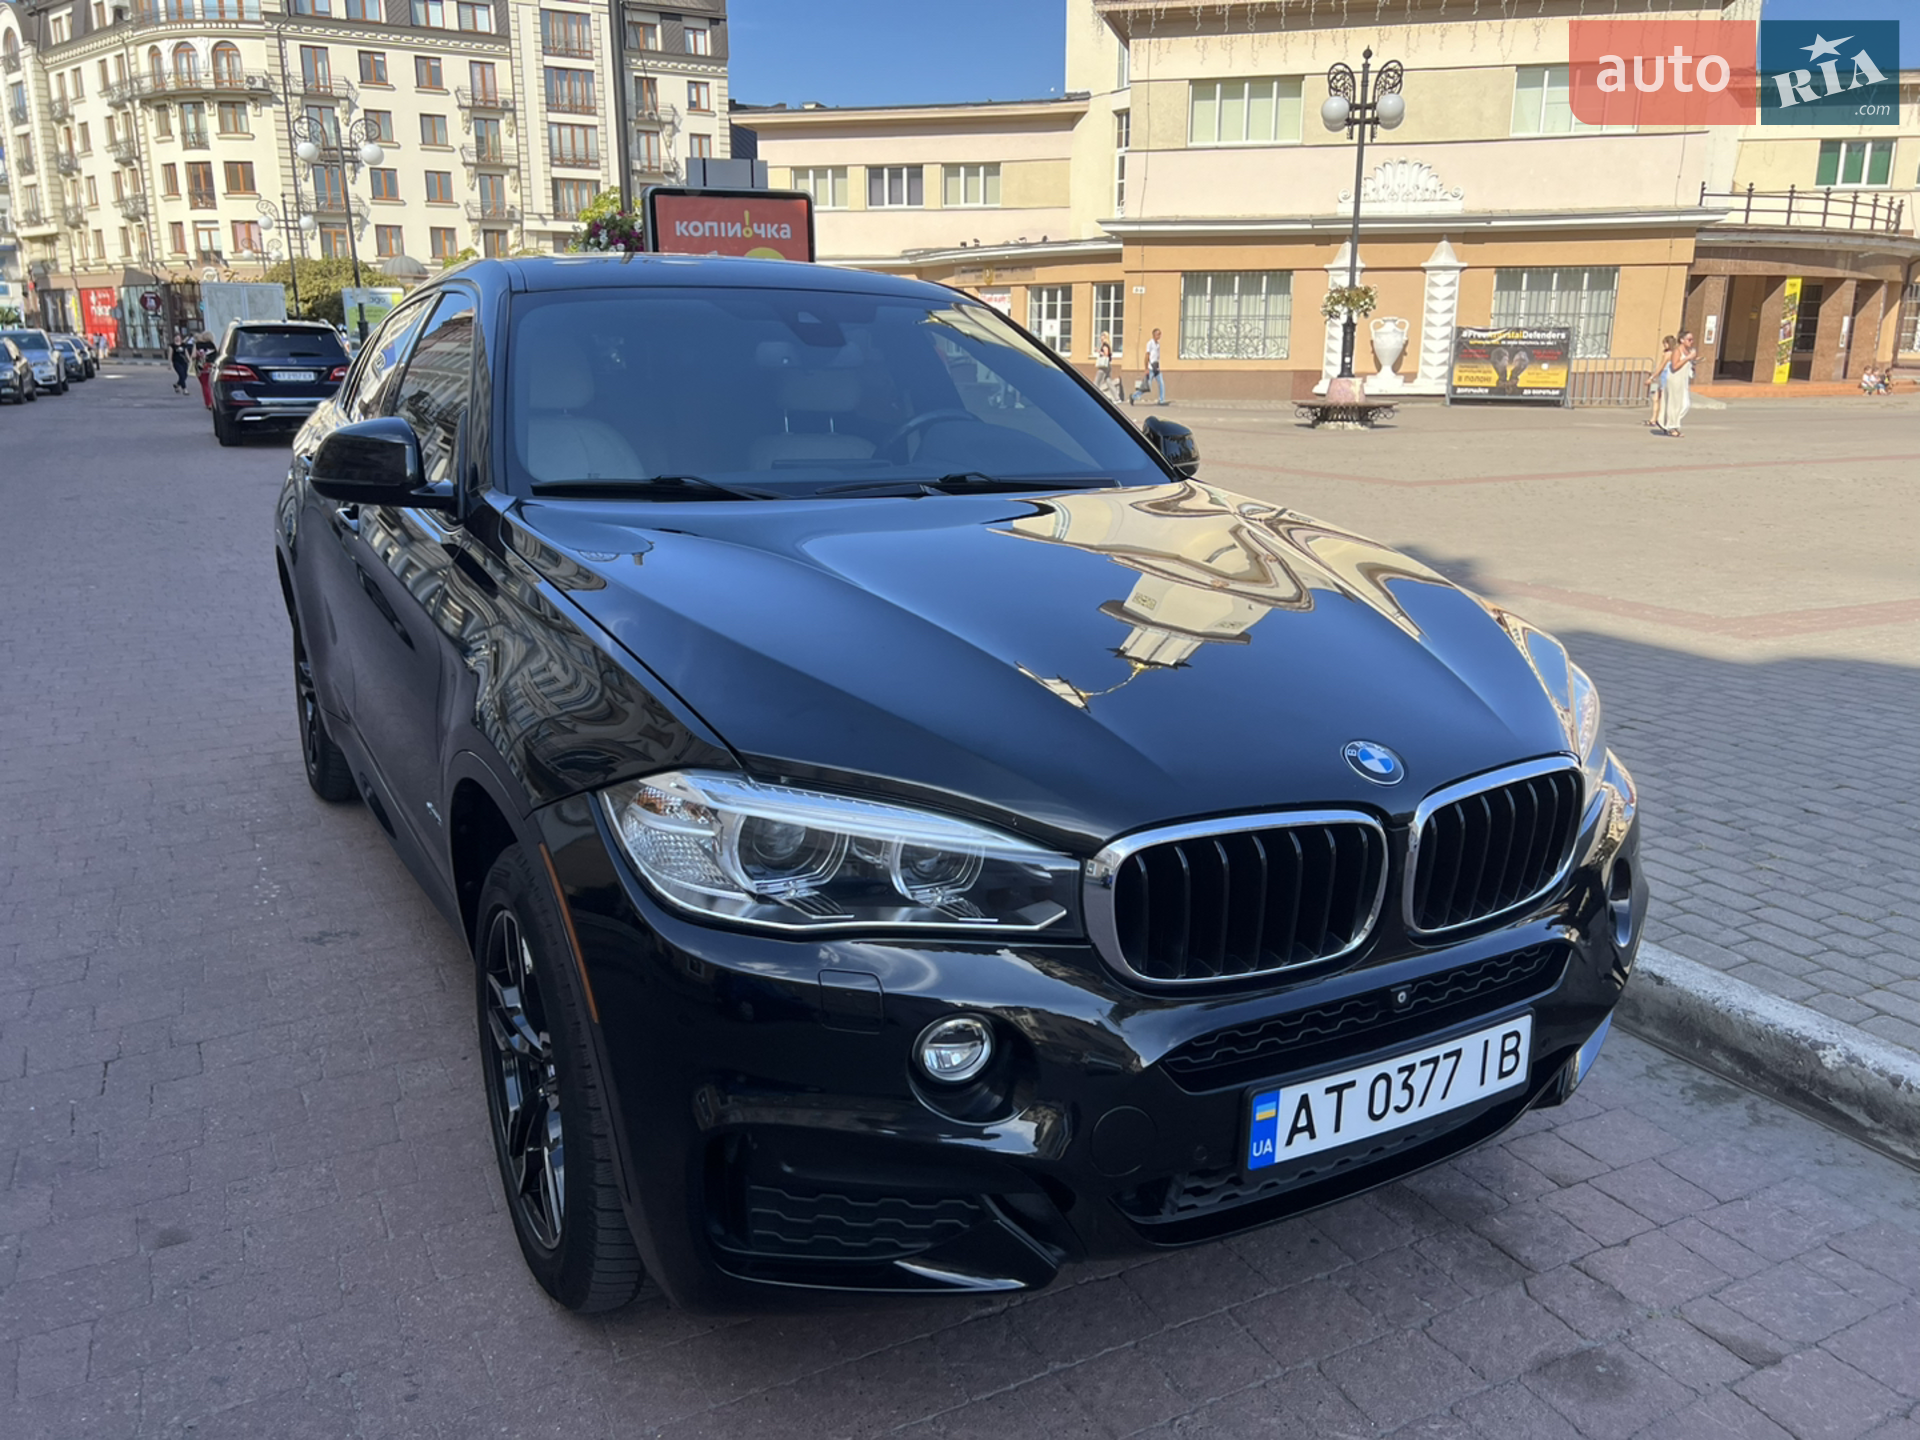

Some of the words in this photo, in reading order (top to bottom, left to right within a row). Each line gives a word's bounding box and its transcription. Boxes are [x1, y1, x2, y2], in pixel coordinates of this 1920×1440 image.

[1285, 1080, 1356, 1147] AT
[1367, 1048, 1462, 1122] 0377
[1480, 1030, 1521, 1087] IB
[1252, 1138, 1273, 1157] UA
